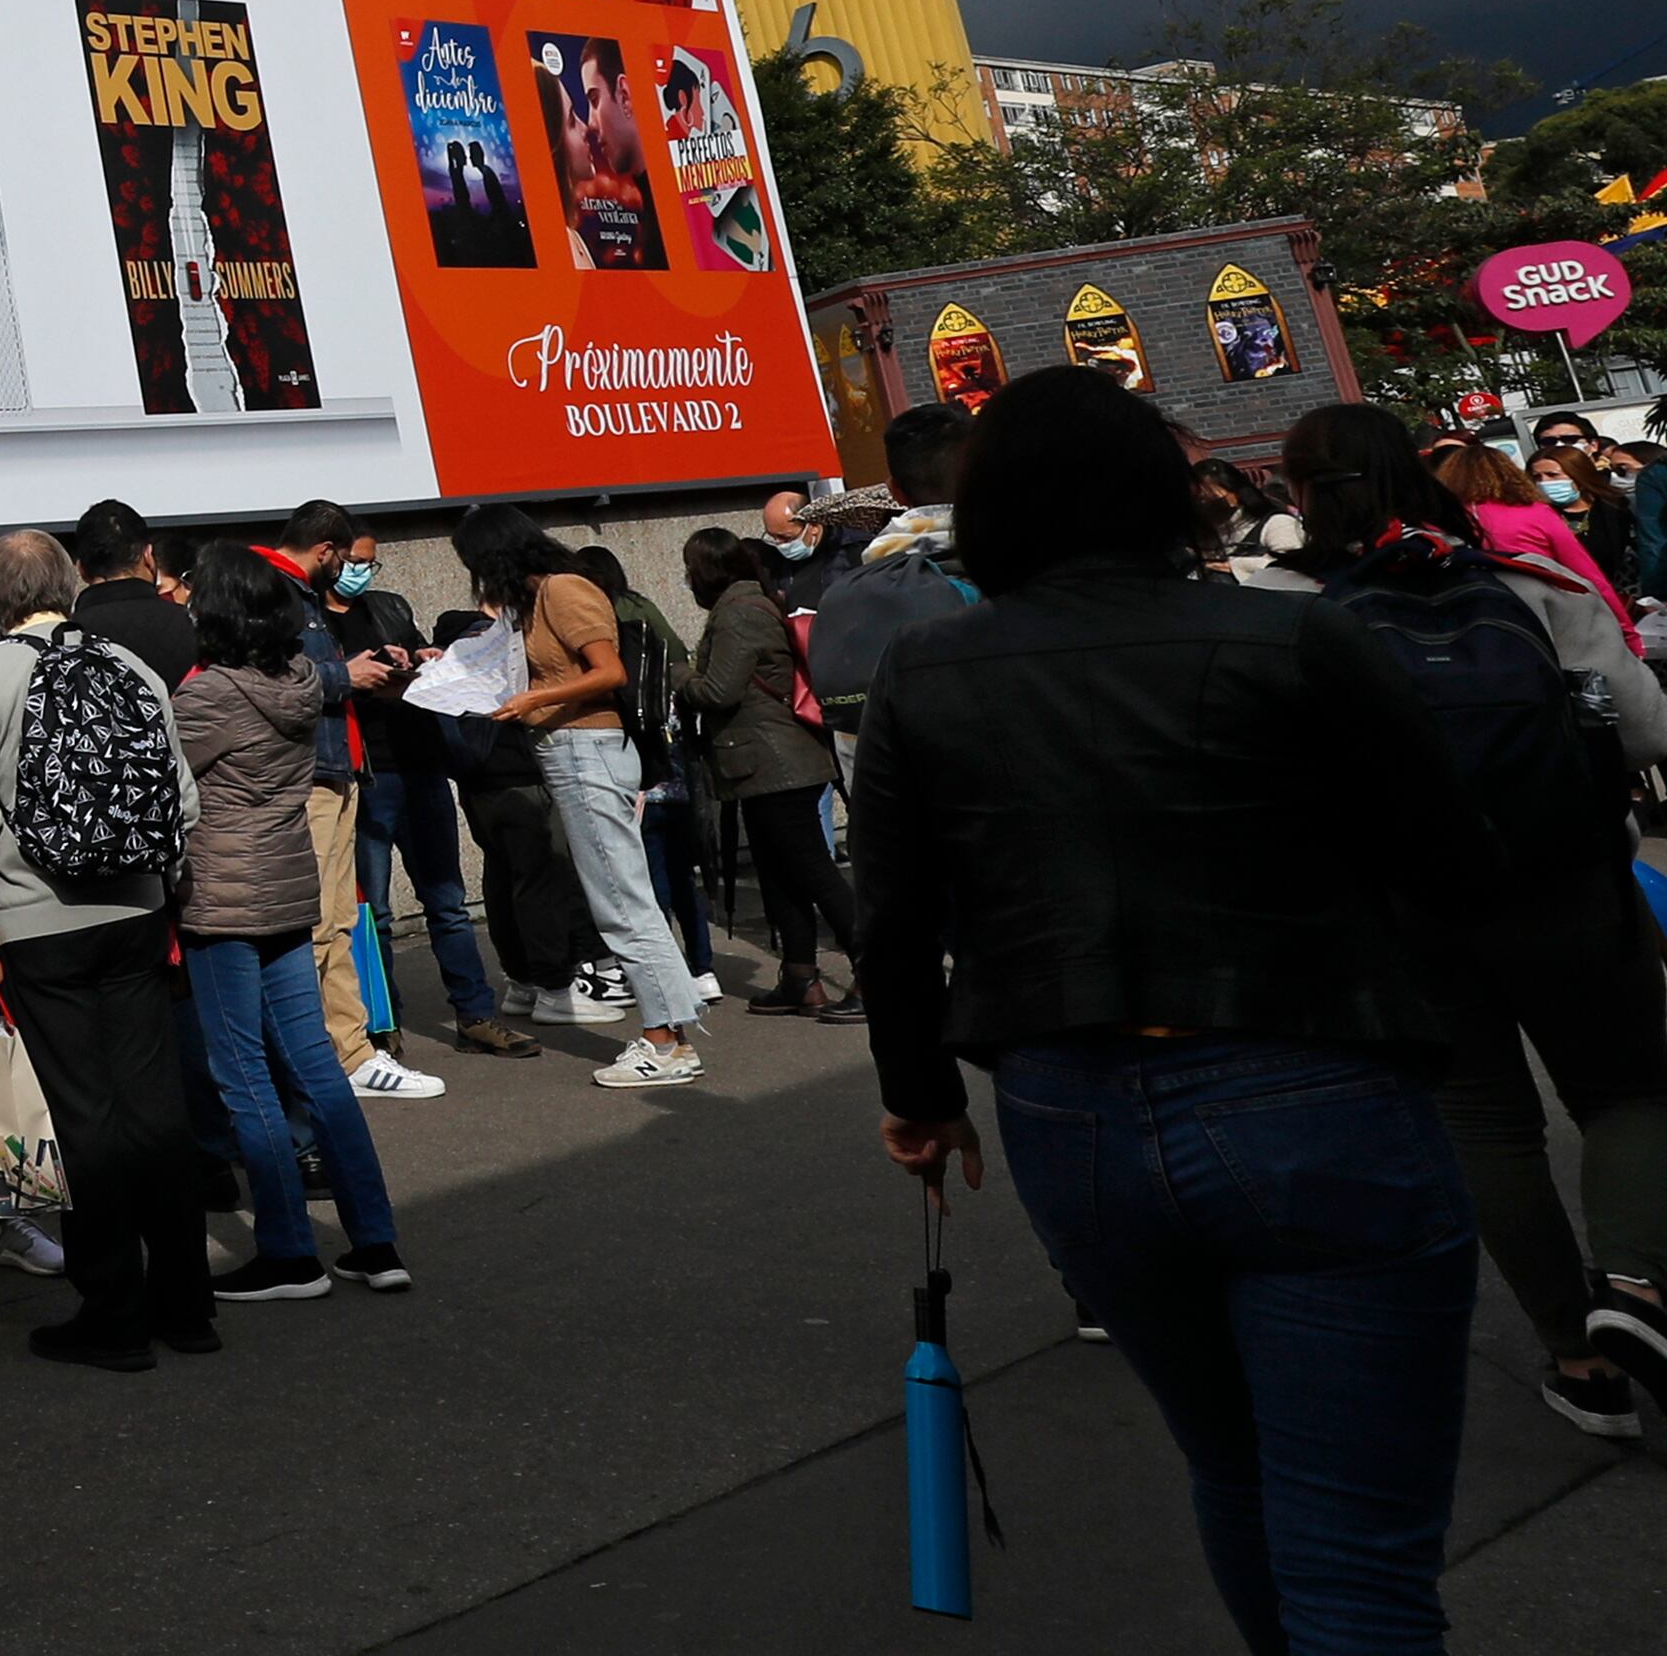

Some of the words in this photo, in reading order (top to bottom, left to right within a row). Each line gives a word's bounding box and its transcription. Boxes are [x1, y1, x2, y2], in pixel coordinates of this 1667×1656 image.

[85, 12, 249, 61] STEPHEN
[422, 27, 475, 72] Antes
[90, 51, 262, 131] KING
[415, 71, 497, 117] diciembre
[678, 131, 735, 167] PERFECTOS
[678, 155, 748, 193] MENTIROSOS
[125, 259, 176, 301] BILLY
[214, 260, 296, 301] SUMMERS
[1502, 274, 1615, 310] Snack
[1517, 260, 1584, 286] GUD
[507, 324, 754, 392] Próximamente
[565, 399, 723, 437] BOULEVARD
[725, 402, 743, 430] 2
